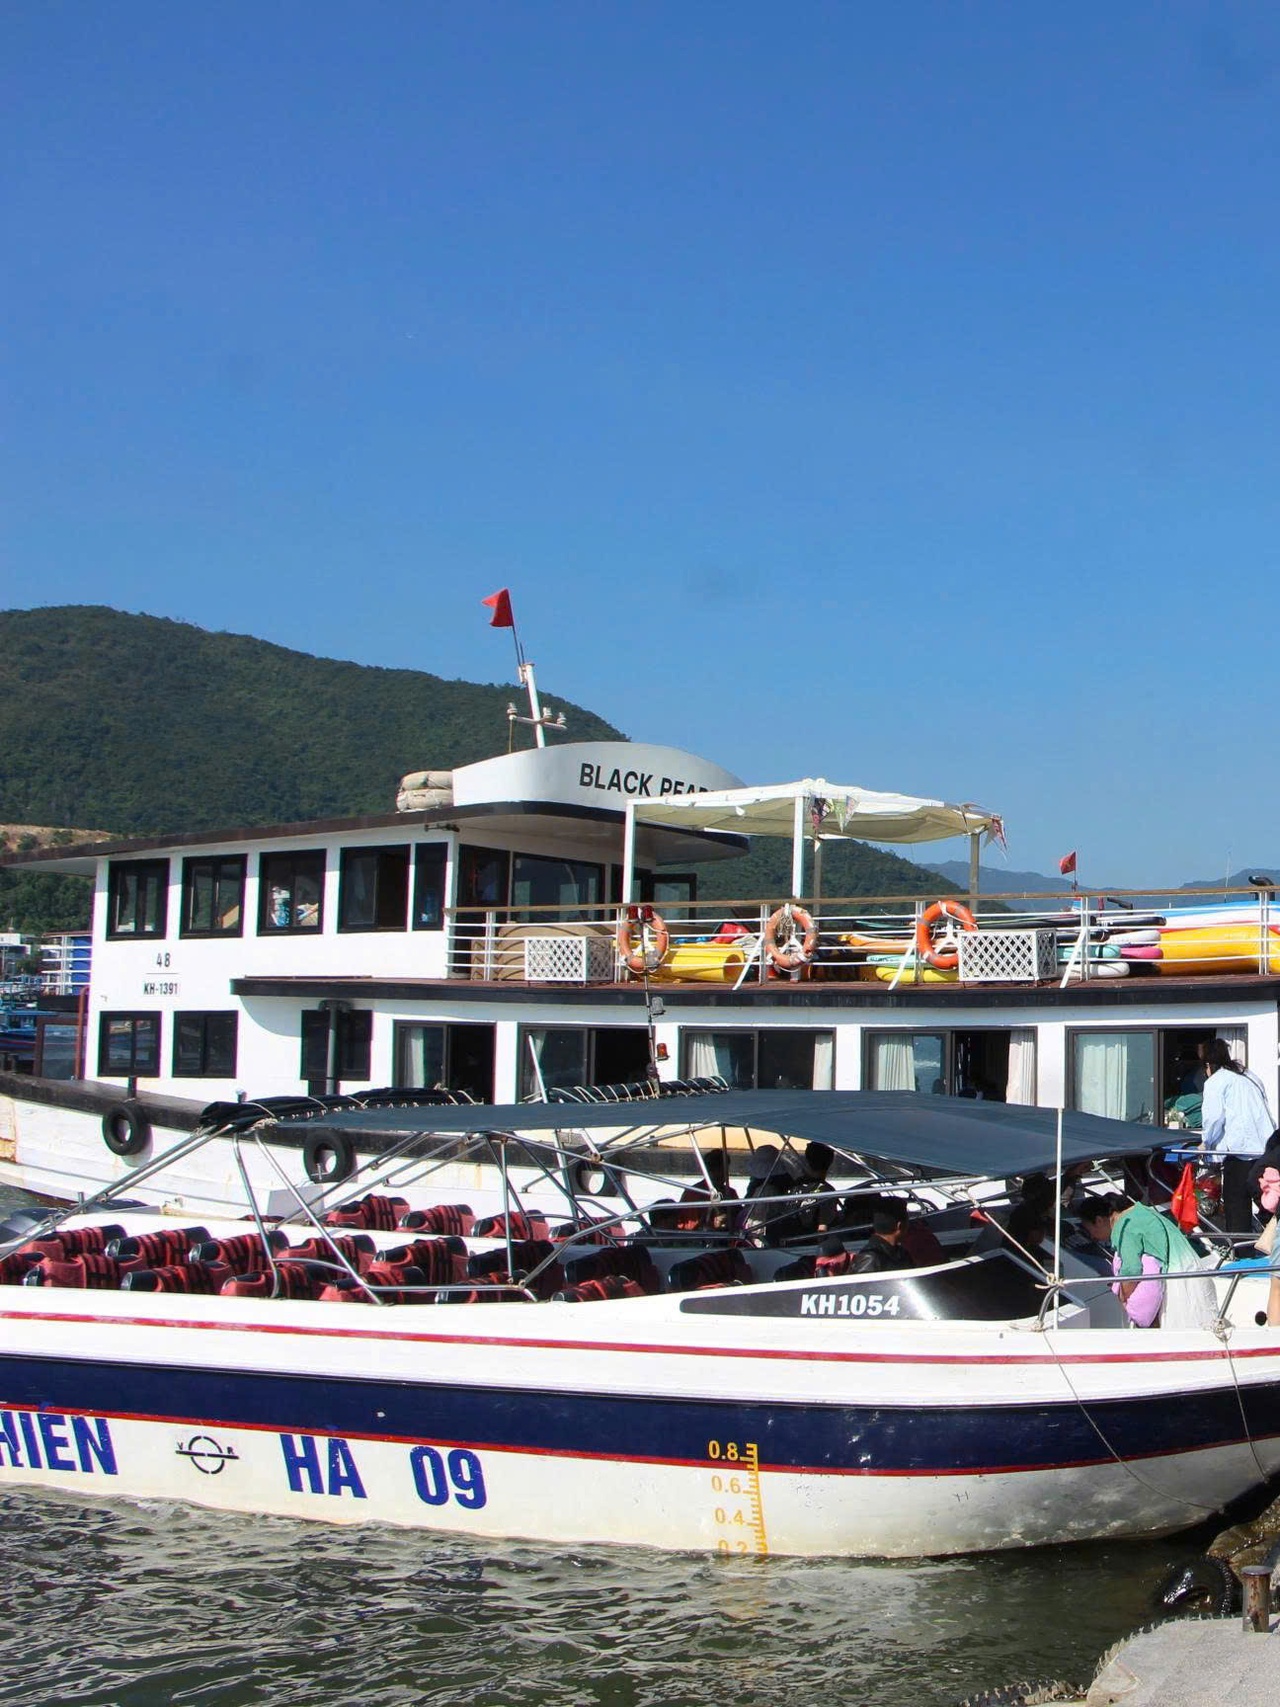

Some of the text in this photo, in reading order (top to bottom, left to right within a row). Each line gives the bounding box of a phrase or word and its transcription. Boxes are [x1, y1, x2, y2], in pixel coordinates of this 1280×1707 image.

[580, 762, 654, 797] BLACK
[156, 953, 171, 968] 48
[143, 982, 178, 996] KH-1391
[800, 1294, 900, 1316] KH1054
[708, 1440, 739, 1461] 0.8
[410, 1445, 487, 1510] 09
[711, 1475, 741, 1494] 0.6
[715, 1507, 744, 1525] 0.4
